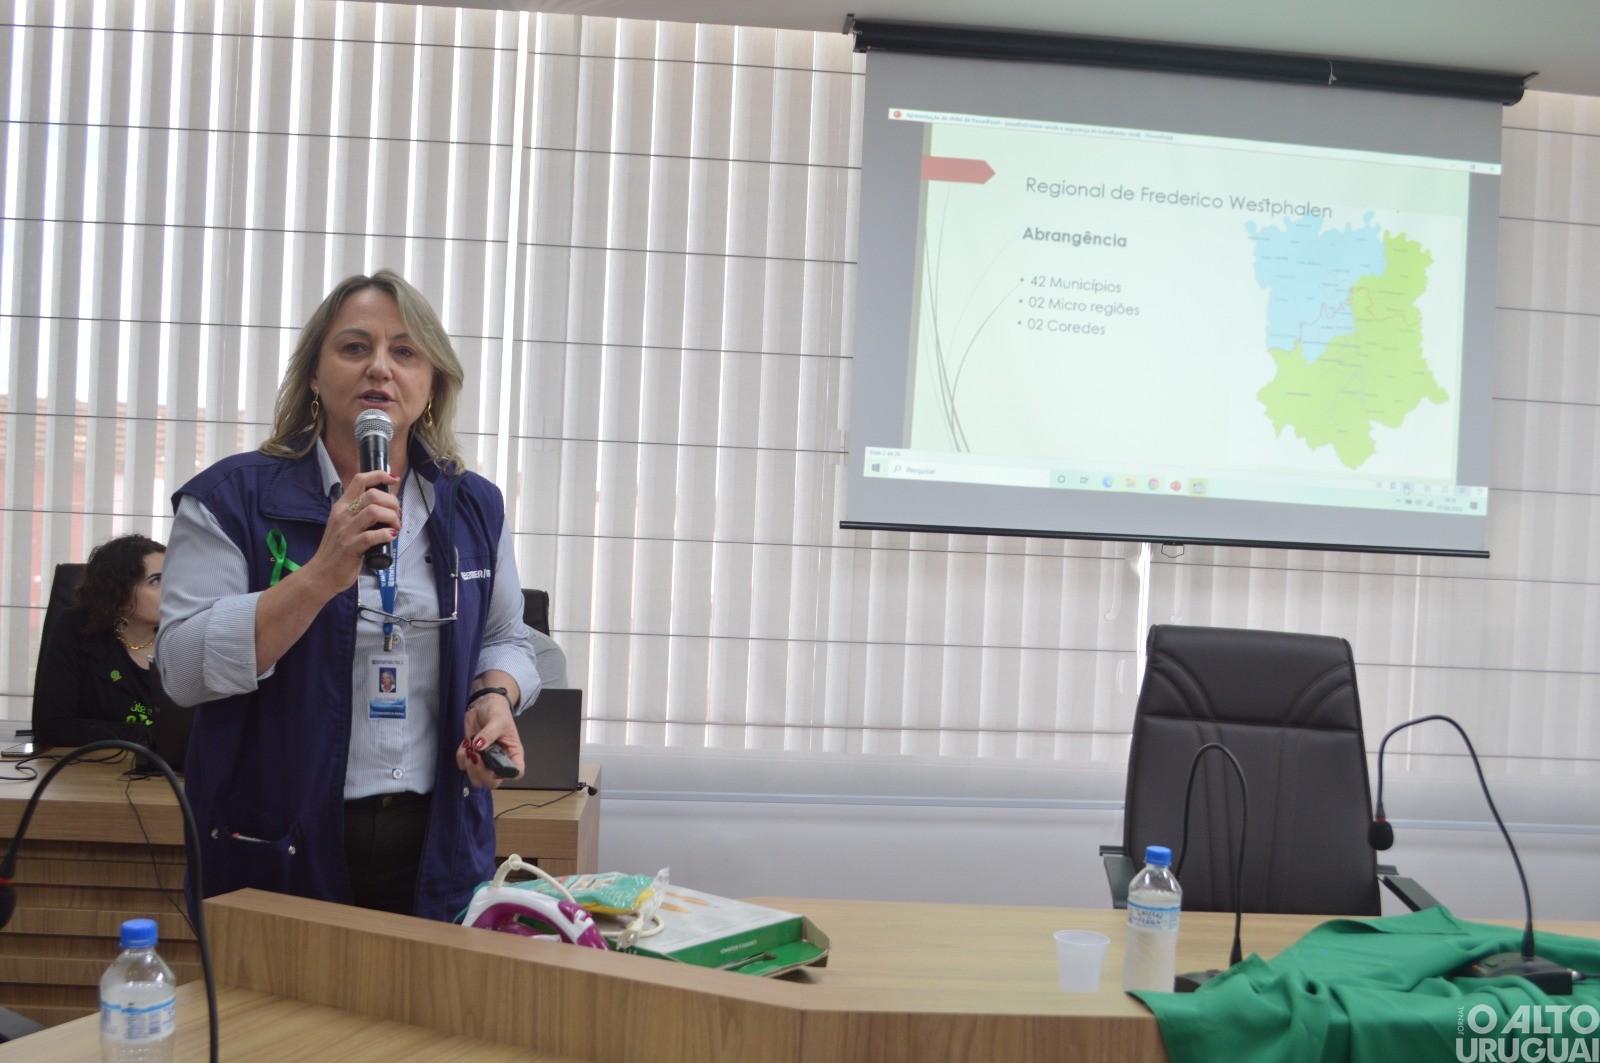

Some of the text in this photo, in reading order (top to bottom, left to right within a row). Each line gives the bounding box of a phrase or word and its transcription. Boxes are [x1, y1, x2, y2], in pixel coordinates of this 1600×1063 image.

[1026, 176, 1333, 218] Regional de Frederico Westphalen
[1022, 226, 1127, 249] Abrangência
[1030, 275, 1122, 294] 42 Municípios
[1028, 296, 1140, 317] 02 Micro regiões
[1027, 318, 1106, 335] 02 Coredes
